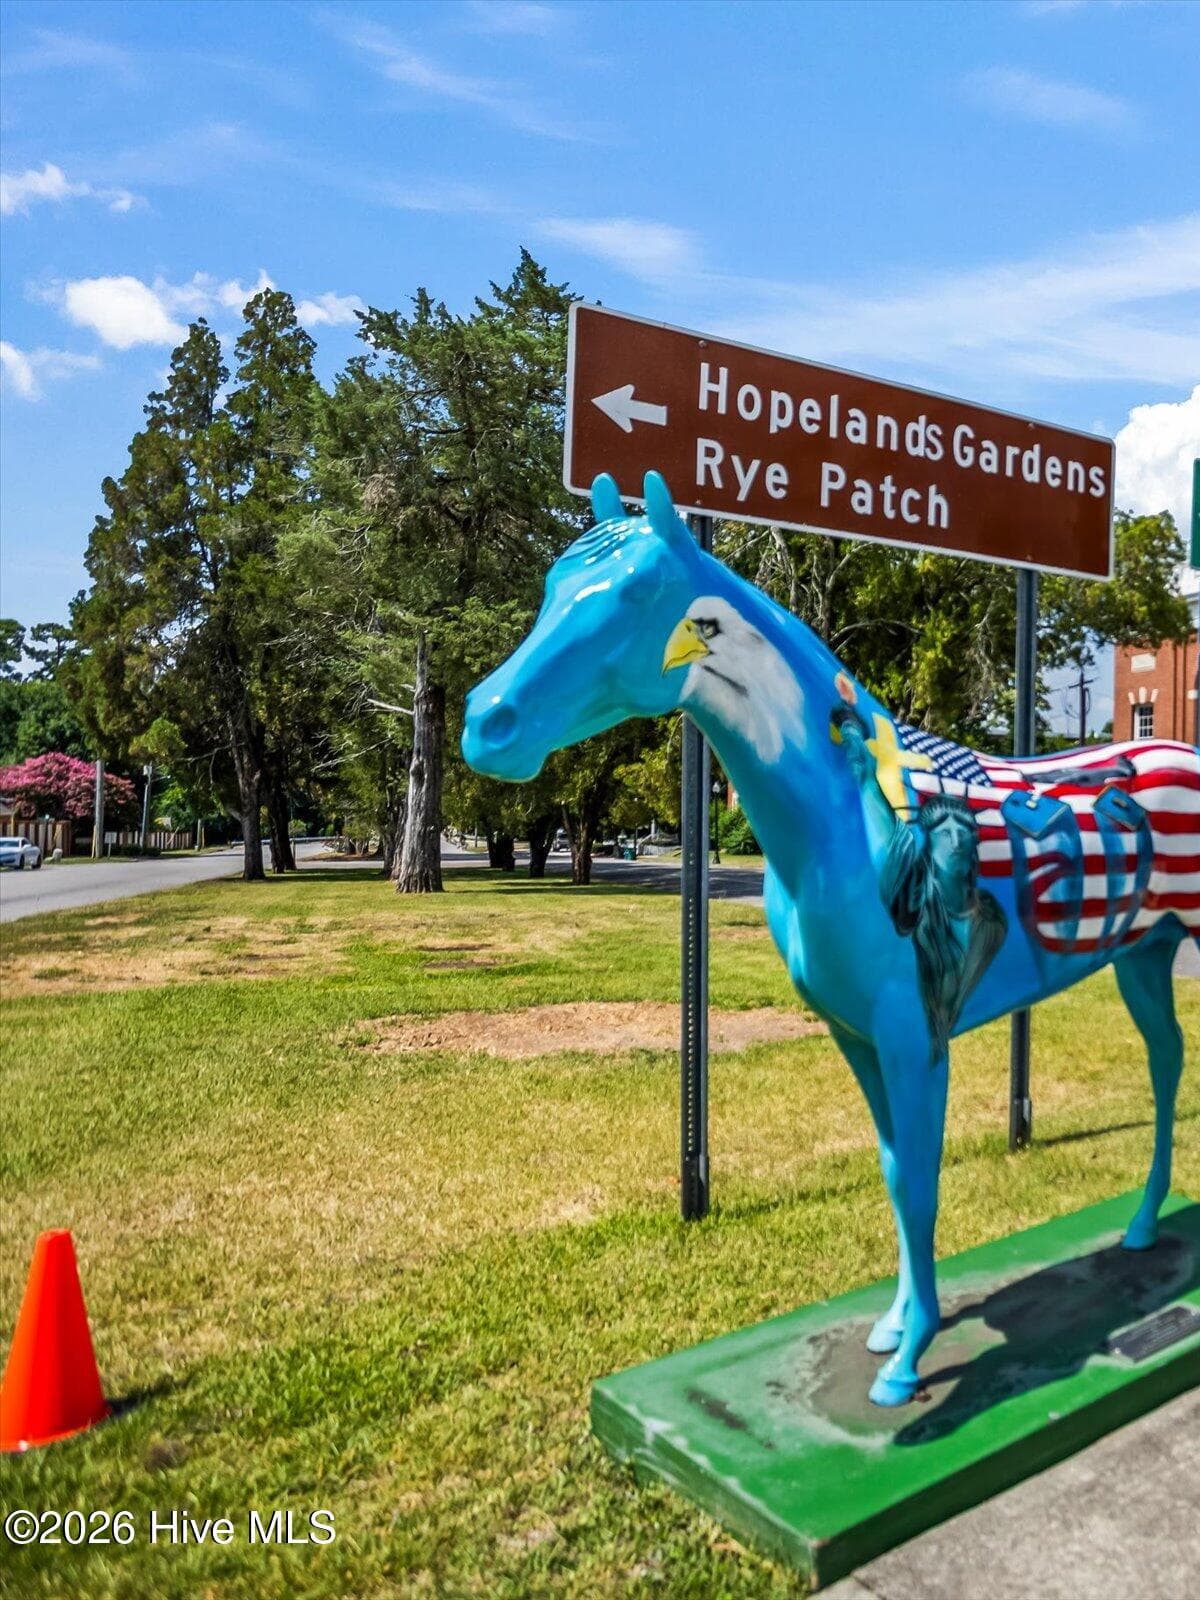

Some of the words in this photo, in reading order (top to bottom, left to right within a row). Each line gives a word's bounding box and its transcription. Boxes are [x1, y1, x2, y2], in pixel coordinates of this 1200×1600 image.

[696, 437, 789, 502] Rye
[821, 462, 950, 530] Patch
[698, 362, 943, 461] Hopelands
[953, 424, 1106, 499] Gardens
